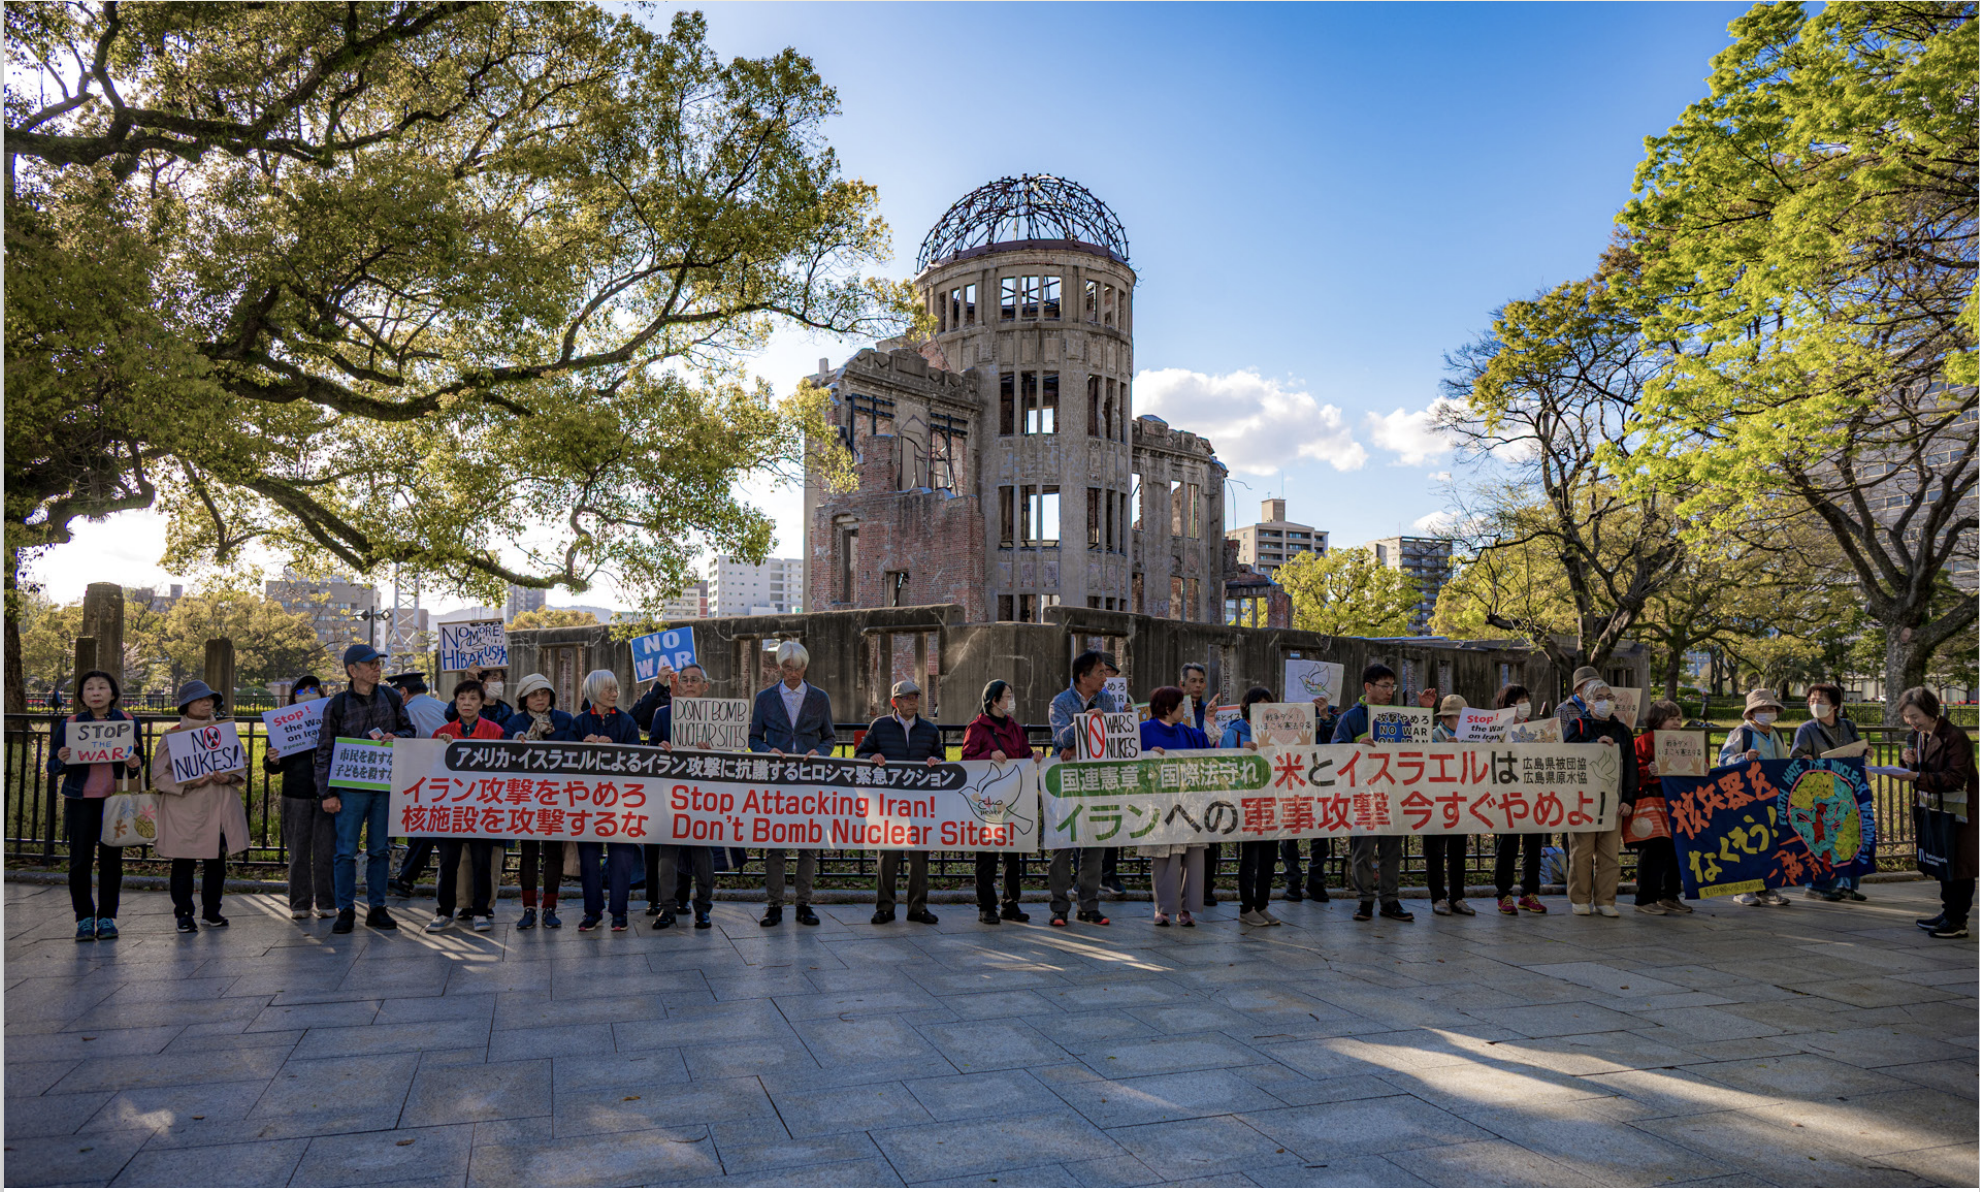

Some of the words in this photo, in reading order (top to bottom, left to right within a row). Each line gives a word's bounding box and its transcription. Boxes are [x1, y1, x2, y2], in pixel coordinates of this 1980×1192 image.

[442, 627, 470, 649] NO
[469, 625, 500, 646] MORE
[643, 631, 680, 655] NO
[442, 645, 509, 670] HIBAKUSHA
[636, 650, 692, 679] WAR
[1106, 682, 1126, 692] めろ
[712, 700, 747, 722] BOMB
[1377, 713, 1430, 725] 攻撃やめろ
[77, 722, 131, 741] STOP
[284, 722, 304, 734] the
[304, 717, 323, 728] Wa
[287, 733, 302, 742] on
[304, 727, 321, 738] Ira
[673, 722, 717, 747] NUCLEAR
[716, 723, 746, 748] SITES
[1104, 714, 1135, 735] WARS
[1379, 725, 1397, 735] NO
[1403, 725, 1428, 736] WAR
[1471, 725, 1487, 733] the
[77, 745, 133, 762] WAR!
[1106, 737, 1139, 760] NUKES
[174, 744, 240, 781] NUKES!
[456, 746, 956, 788] アメリカ・イスラエルによるイラン攻撃に抗議するヒロシマ緊急アクション
[1274, 751, 1520, 791] 米とイスラエルは
[1522, 756, 1587, 770] 広島県被団協
[1782, 759, 1804, 786] HATE
[1808, 759, 1826, 770] THE
[1060, 761, 1260, 792] 国連憲章・国際法守れ
[1523, 771, 1588, 785] 広島県原水協
[1830, 760, 1869, 796] NUCLEAR
[402, 776, 647, 809] イラン攻撃をやめろ
[670, 784, 734, 816] Stop
[742, 788, 870, 818] Attacking
[878, 794, 936, 818] Iran!
[1669, 761, 1780, 840] 核兵器を
[1055, 791, 1391, 842] イランへの軍事攻撃
[1776, 788, 1790, 826] EARTH
[401, 804, 649, 838] 核施設を攻撃するな
[672, 813, 744, 842] Don't
[752, 817, 823, 844] Bomb
[831, 818, 933, 846] Nuclear
[940, 821, 1015, 847] Sites!
